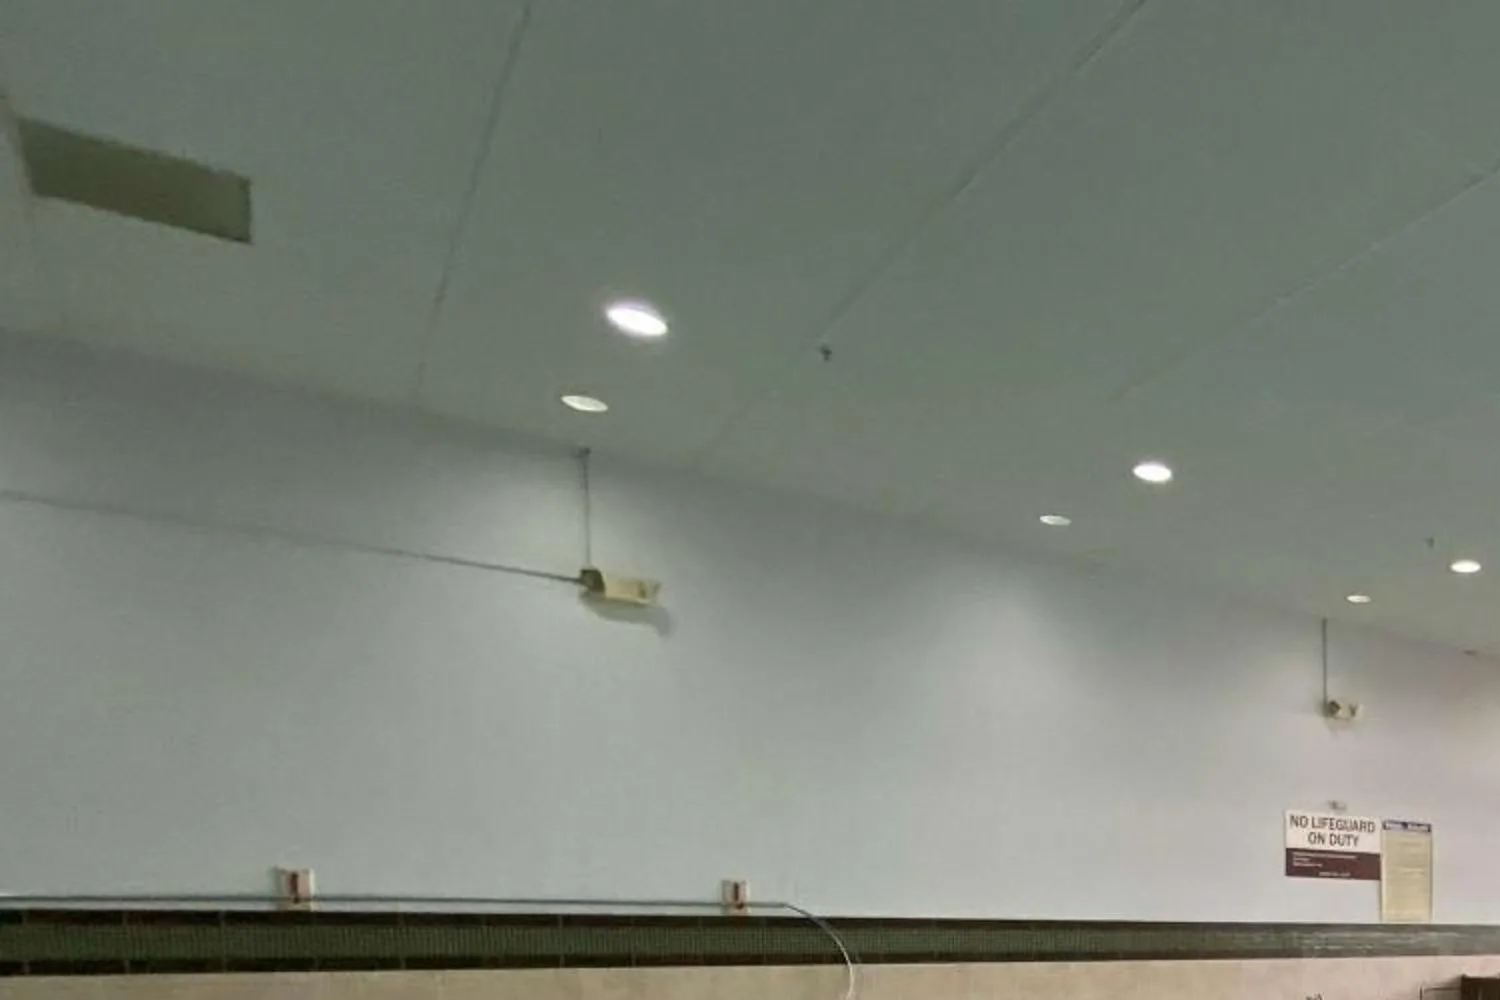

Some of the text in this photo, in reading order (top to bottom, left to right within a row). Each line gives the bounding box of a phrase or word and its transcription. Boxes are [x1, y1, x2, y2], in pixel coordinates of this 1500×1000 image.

[1290, 815, 1308, 828] NO
[1311, 816, 1376, 833] LIFEGUARD
[1308, 831, 1359, 847] ON DUTY
